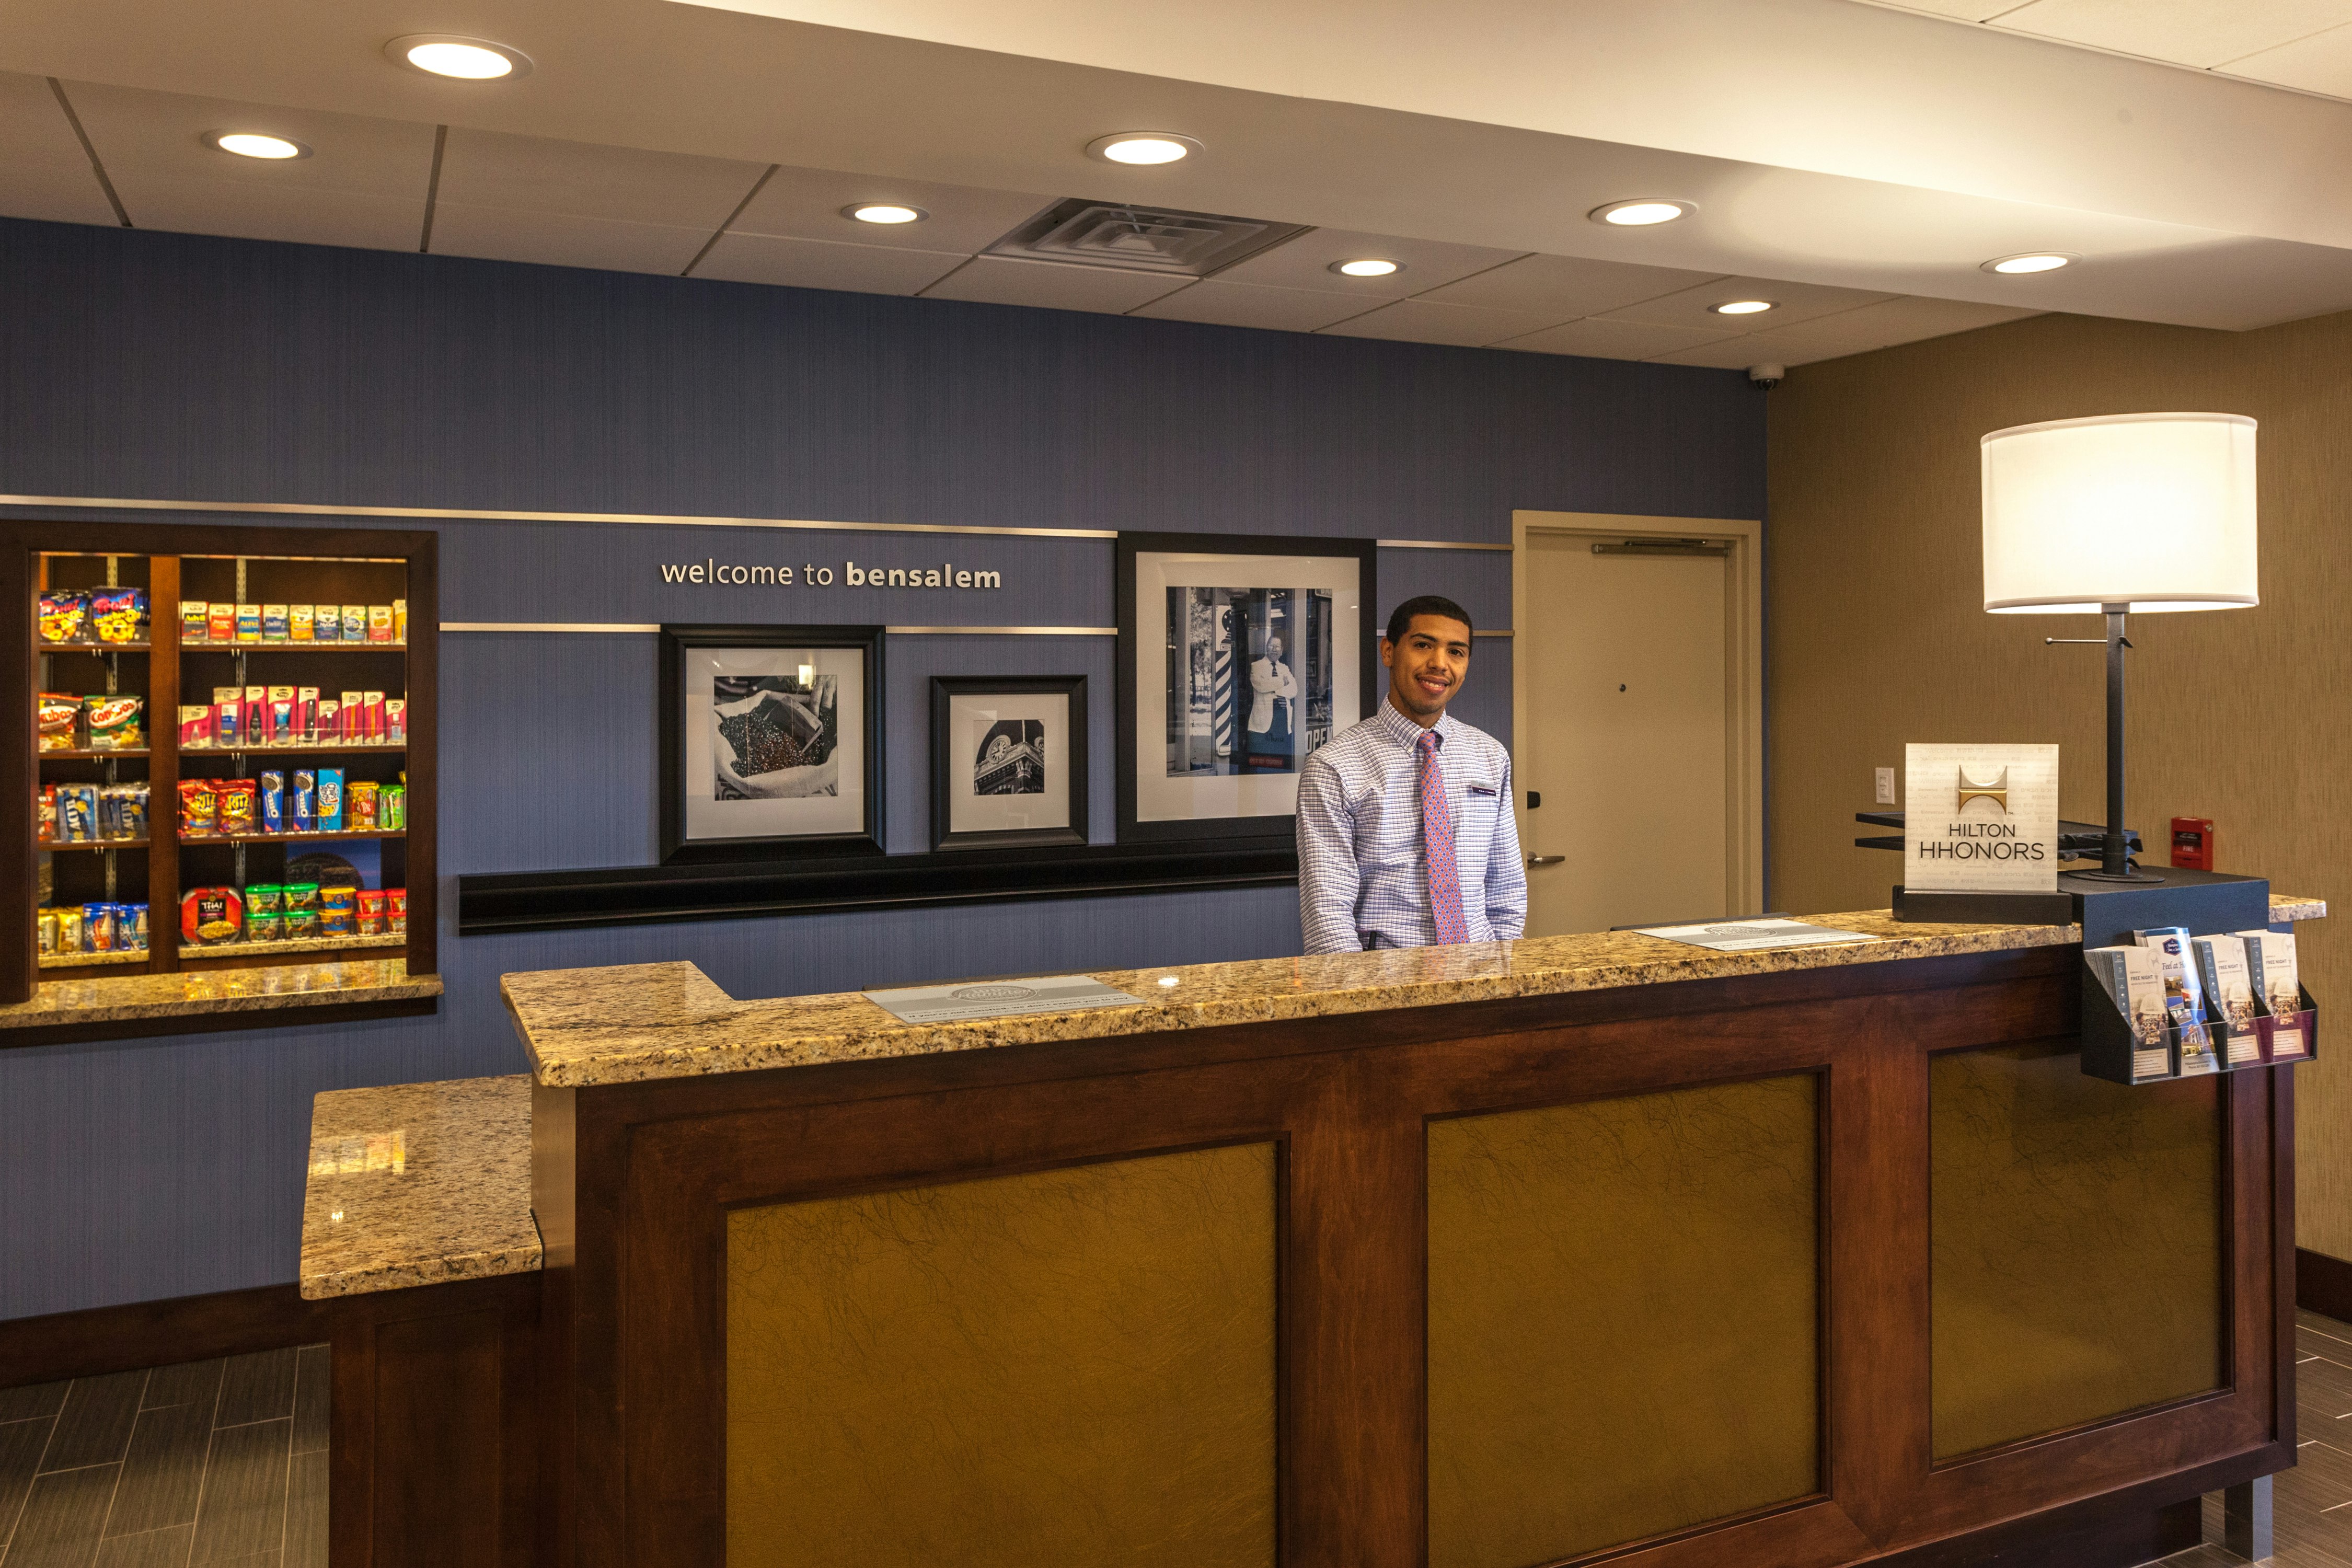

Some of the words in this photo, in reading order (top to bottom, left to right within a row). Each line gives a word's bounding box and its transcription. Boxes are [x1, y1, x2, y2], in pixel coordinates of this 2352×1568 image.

[661, 559, 793, 585] welcome
[803, 563, 833, 585] to
[847, 562, 1001, 589] bensalem
[227, 794, 249, 811] RITZ
[267, 792, 279, 818] OREO
[299, 791, 308, 818] OREO
[1950, 823, 2015, 837] HILTON
[1920, 841, 2044, 860] HHONORS
[2162, 961, 2172, 970] Feel
